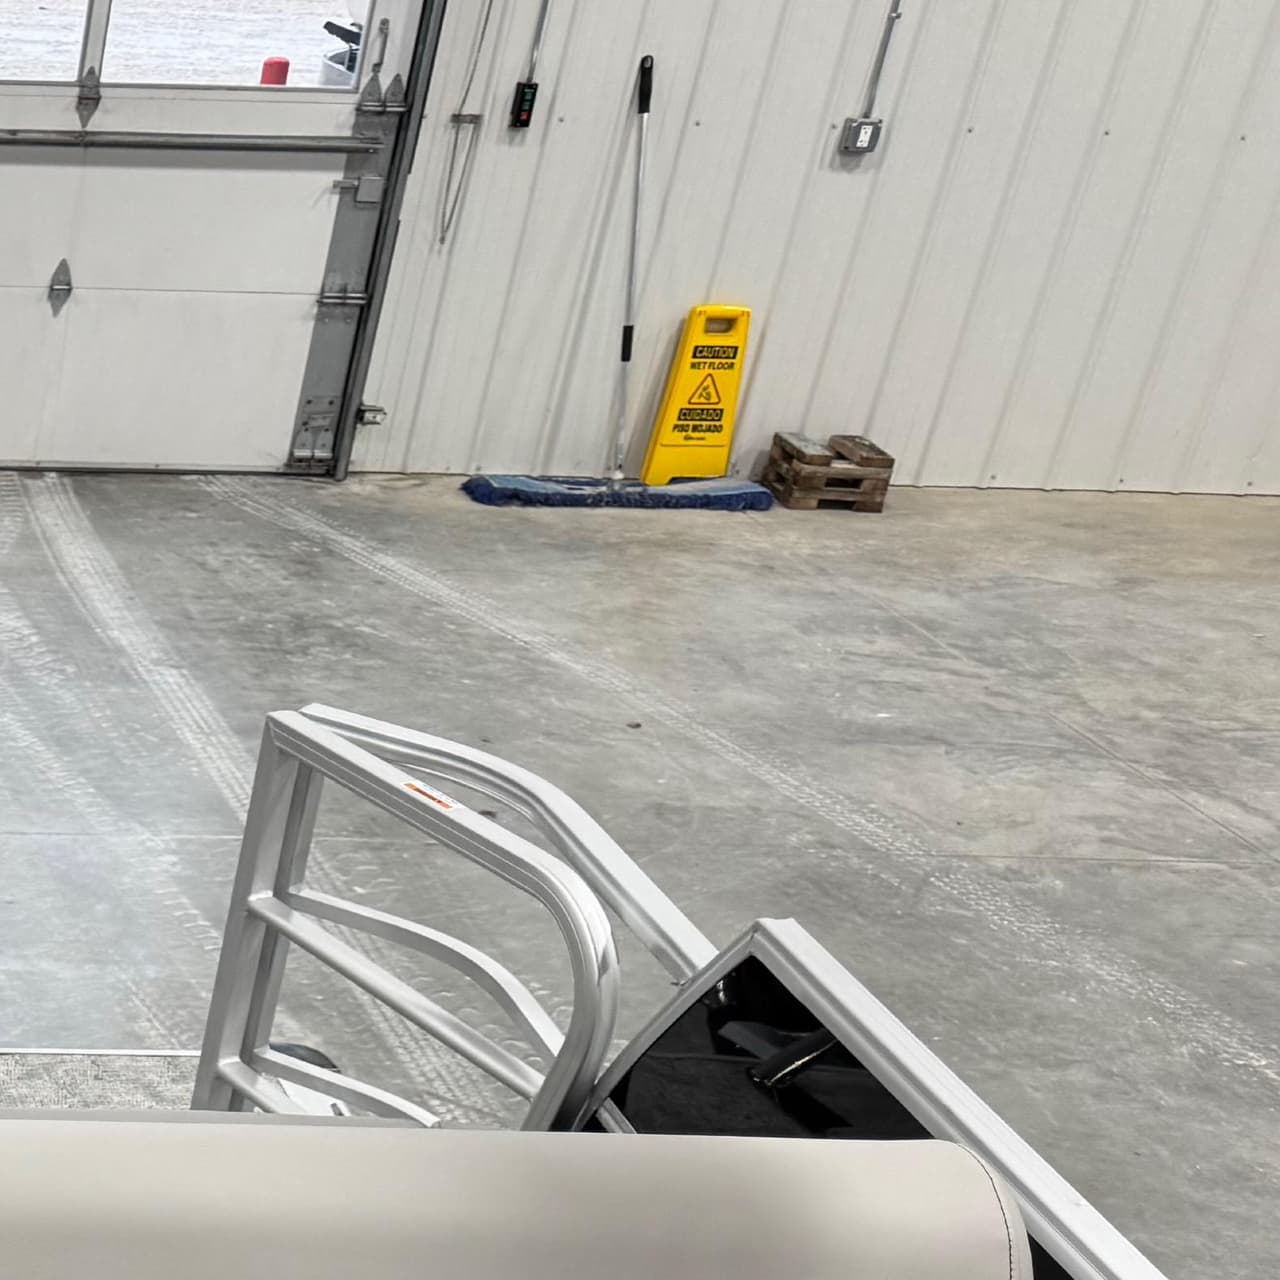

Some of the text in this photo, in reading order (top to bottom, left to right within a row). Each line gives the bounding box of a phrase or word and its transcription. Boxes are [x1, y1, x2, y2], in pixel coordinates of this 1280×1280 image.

[695, 346, 735, 357] CAUTION
[691, 361, 735, 370] WET FLOOR
[679, 409, 721, 420] CUIDADO
